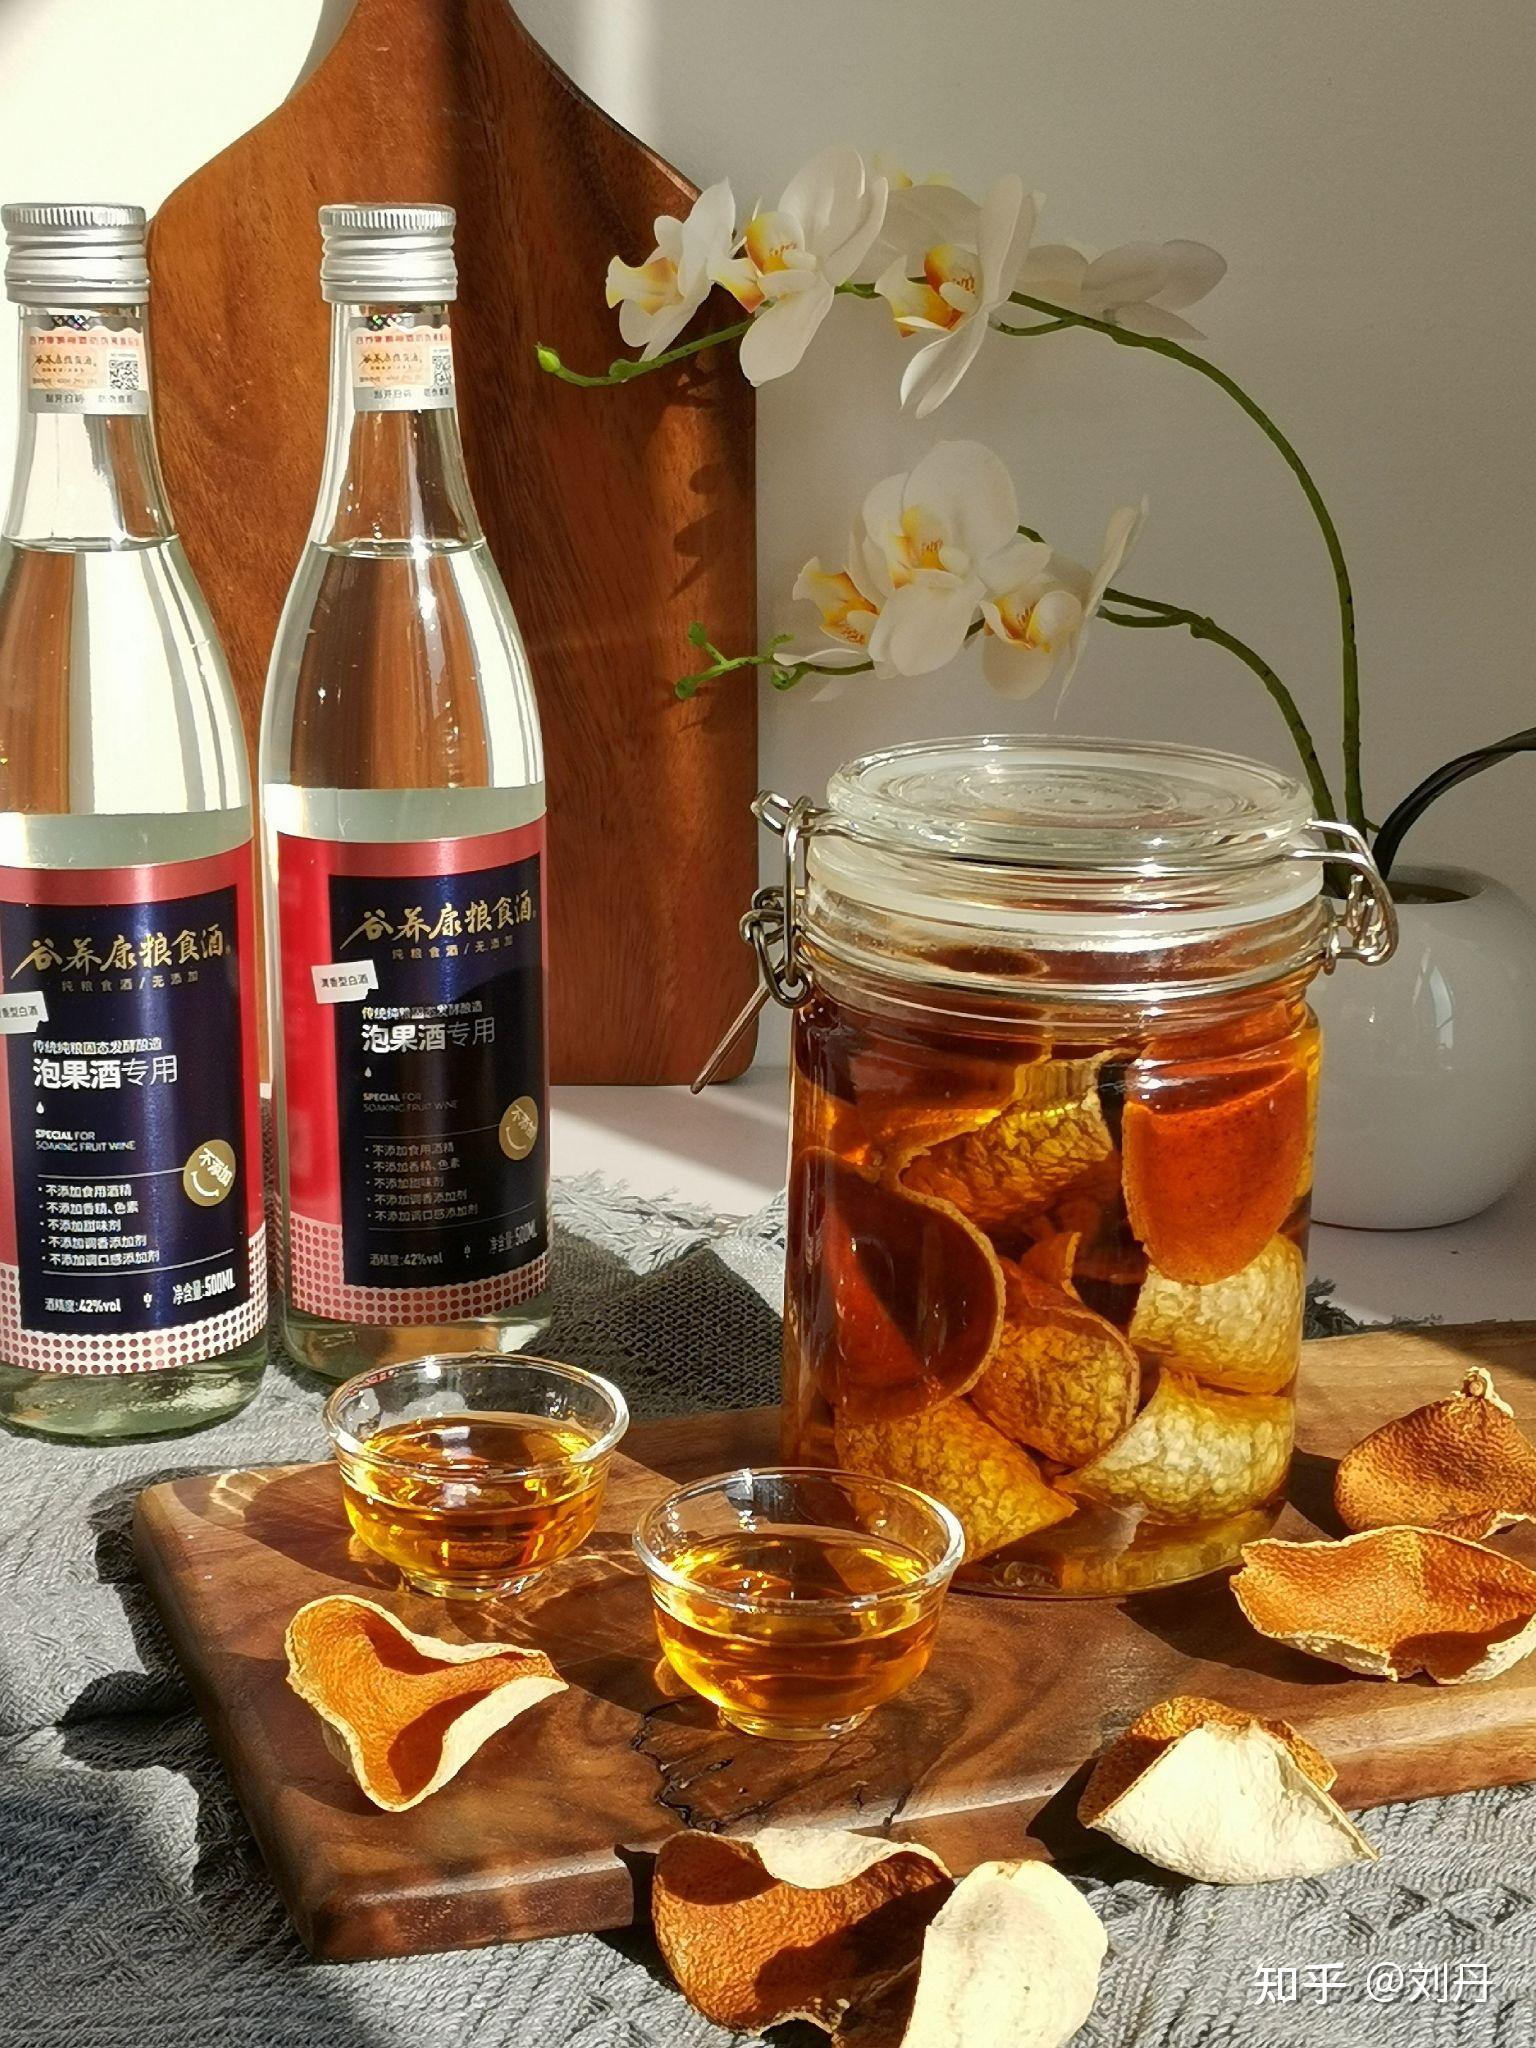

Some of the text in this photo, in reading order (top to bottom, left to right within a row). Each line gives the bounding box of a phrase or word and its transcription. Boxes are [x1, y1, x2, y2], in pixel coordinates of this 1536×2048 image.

[361, 1016, 496, 1054] 泡果酒专用
[33, 1054, 178, 1090] 泡果酒专用
[35, 1129, 73, 1140] SPECIAL
